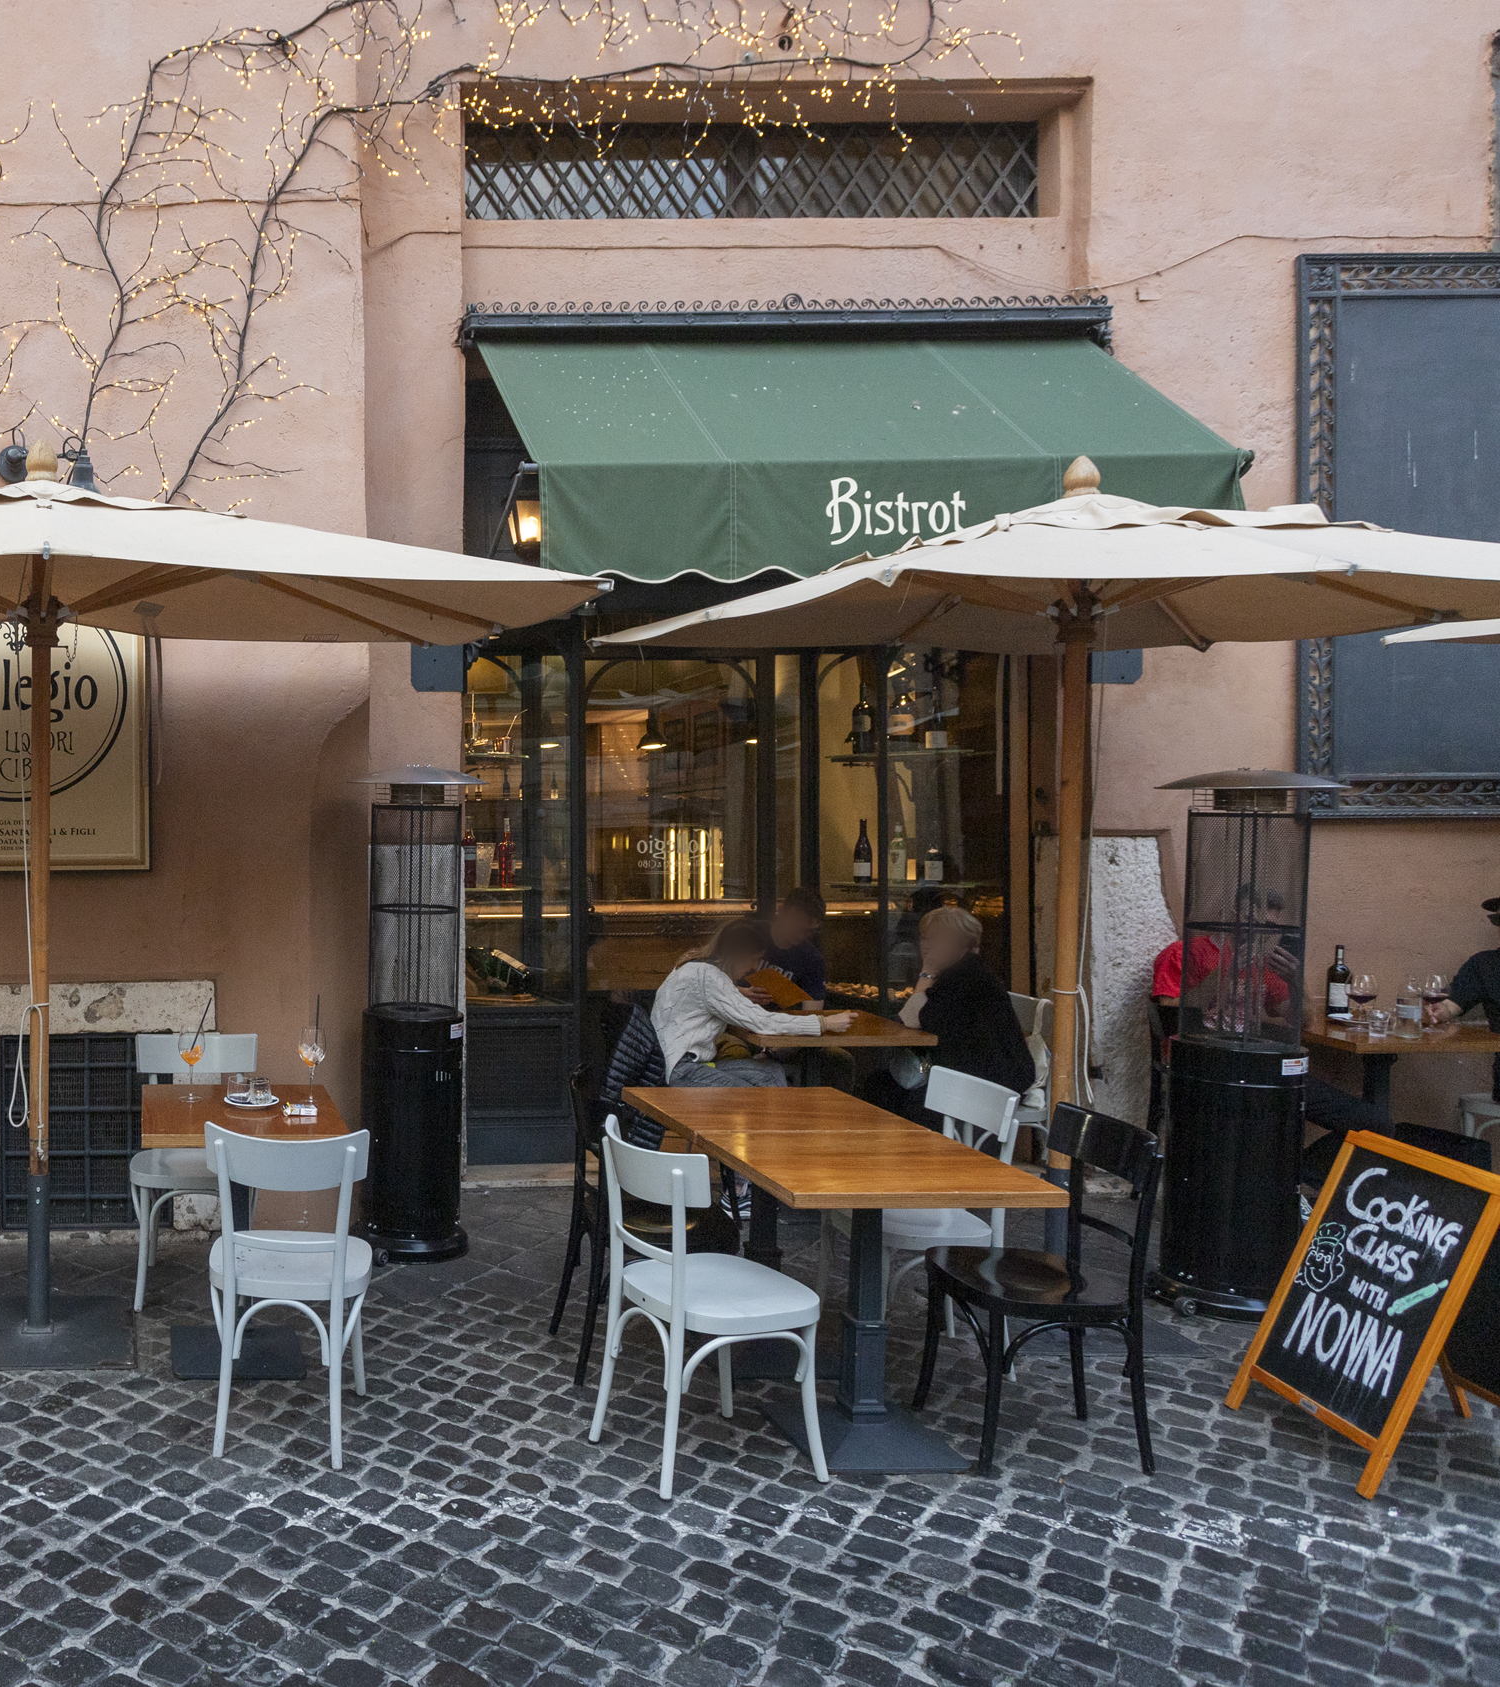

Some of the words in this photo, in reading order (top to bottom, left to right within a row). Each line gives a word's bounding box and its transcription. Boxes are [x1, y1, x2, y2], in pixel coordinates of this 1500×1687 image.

[825, 476, 966, 546] Bistrot
[5, 730, 75, 756] LIQRI
[0, 757, 31, 783] CIB
[71, 828, 96, 836] FIGLI
[1347, 1274, 1389, 1312] WITH
[1282, 1291, 1404, 1398] NONNA
